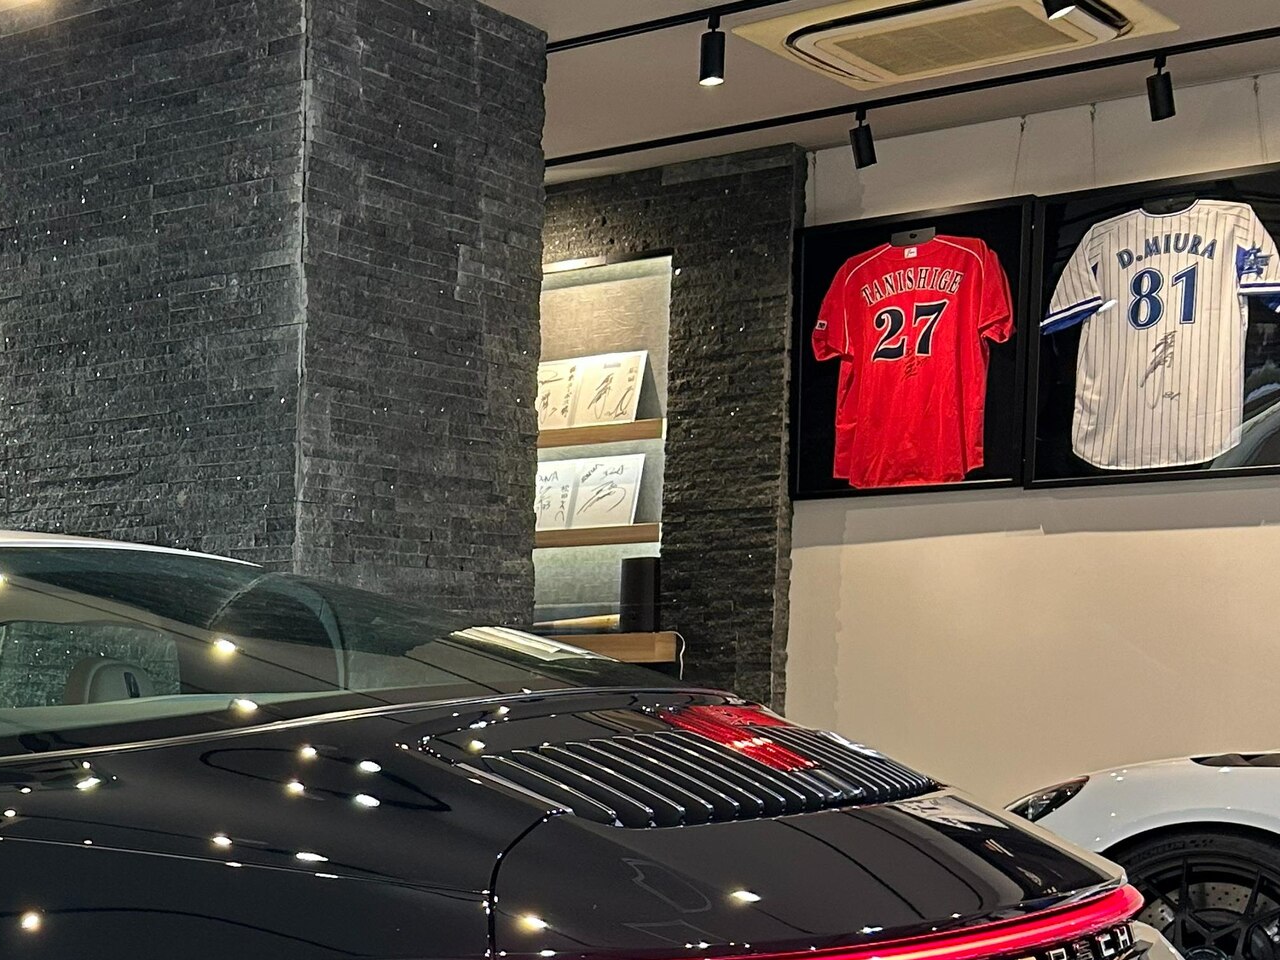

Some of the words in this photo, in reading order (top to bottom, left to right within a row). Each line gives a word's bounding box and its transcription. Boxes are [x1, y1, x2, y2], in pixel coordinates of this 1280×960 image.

[1116, 233, 1218, 269] D.MIURA
[861, 267, 964, 307] TANISHIGE
[1127, 262, 1199, 330] 81
[871, 299, 949, 362] 27
